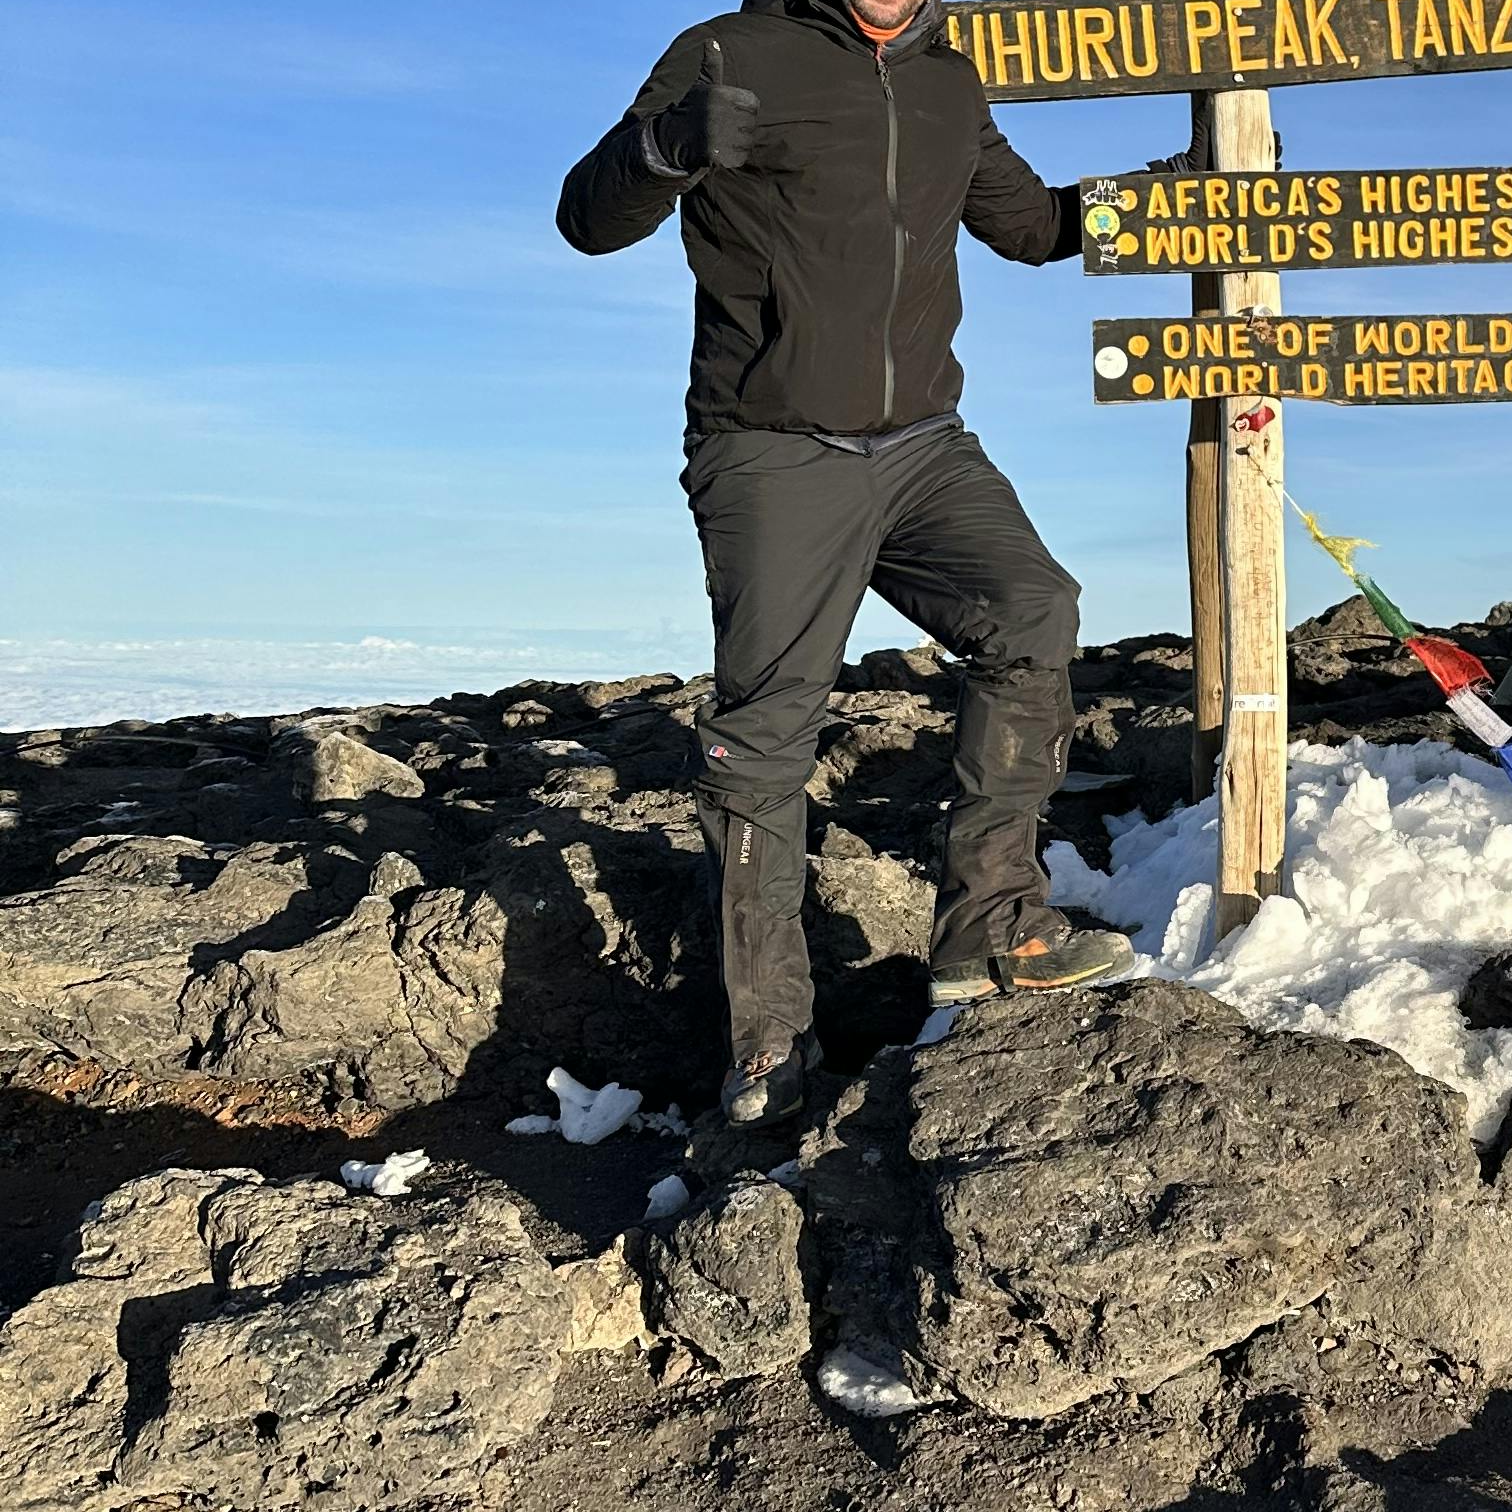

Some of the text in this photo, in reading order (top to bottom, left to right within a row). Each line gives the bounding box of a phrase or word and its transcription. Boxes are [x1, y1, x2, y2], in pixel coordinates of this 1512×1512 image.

[1146, 176, 1342, 219] AFRICA'S
[1146, 221, 1335, 266] WORLD'S
[1163, 322, 1255, 360] ONE
[1276, 321, 1334, 357] OF
[739, 822, 752, 865] UNIGEAR
